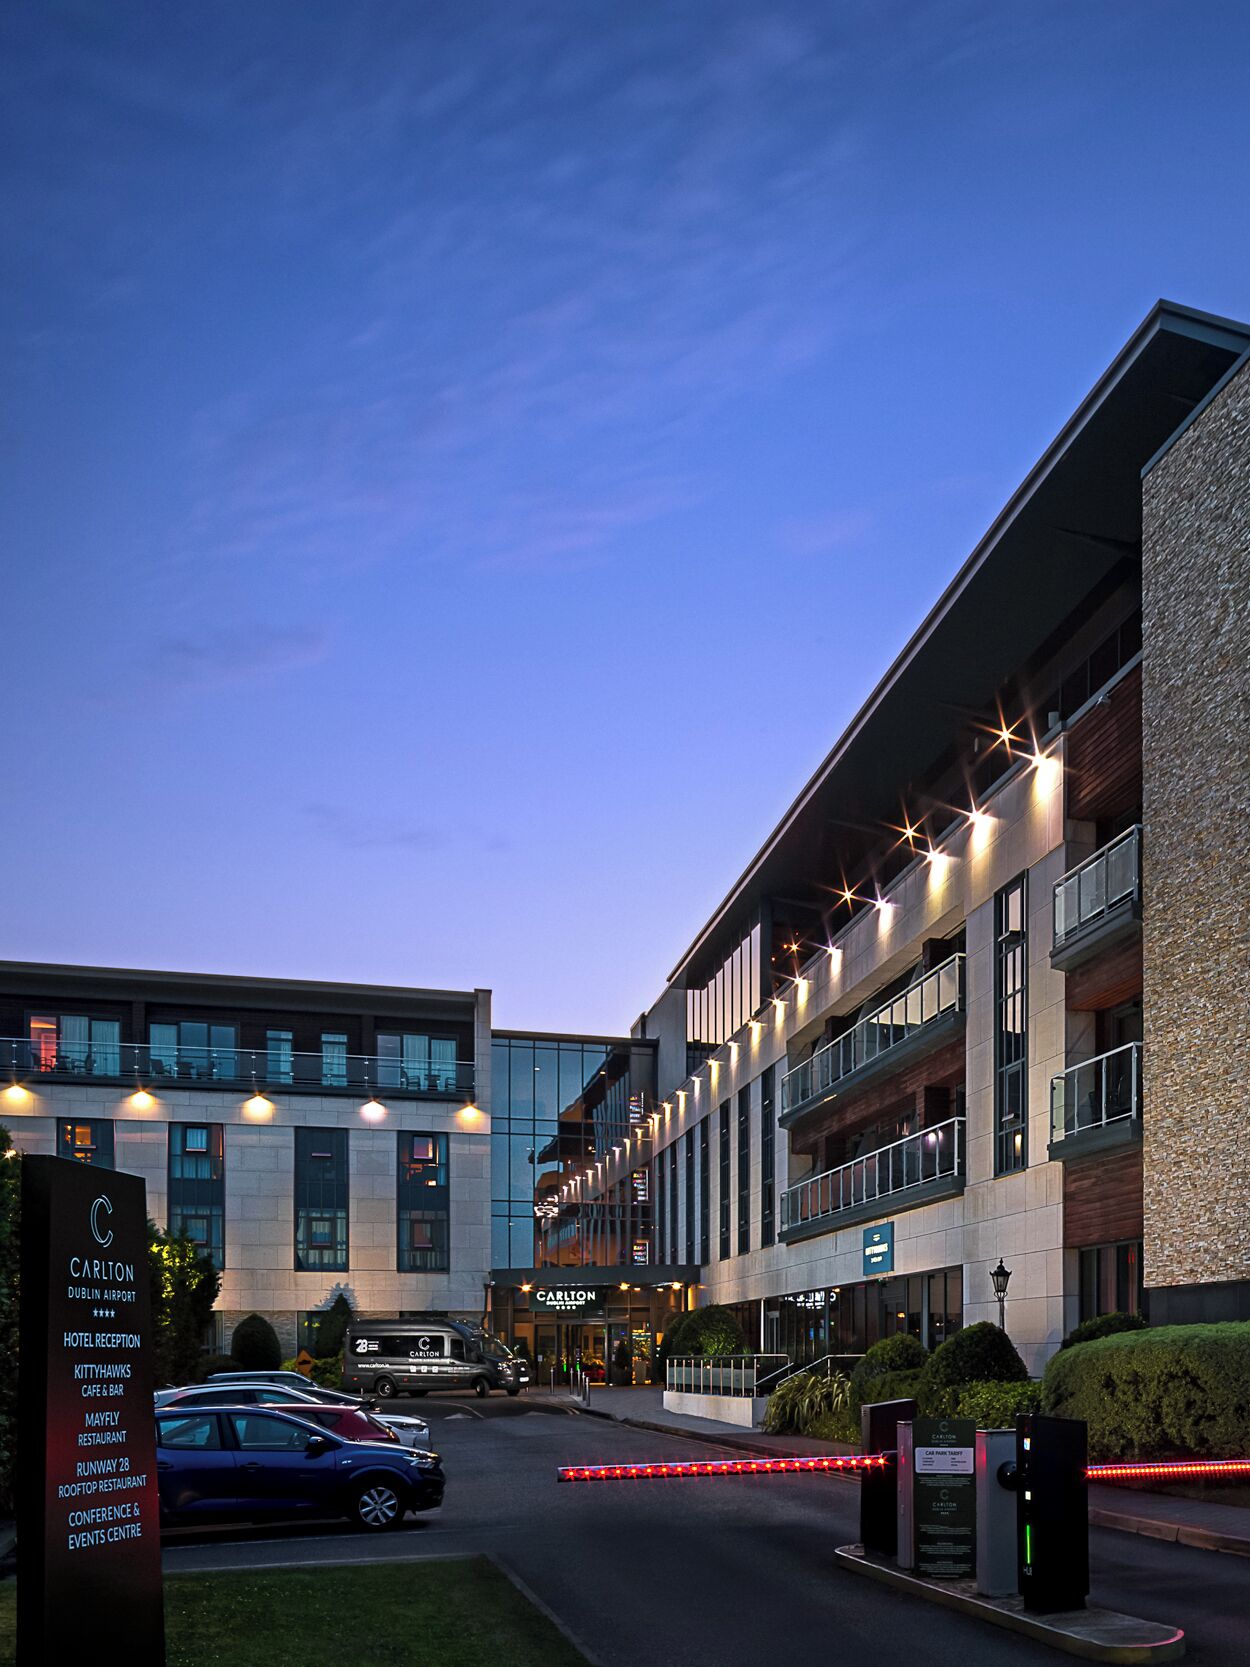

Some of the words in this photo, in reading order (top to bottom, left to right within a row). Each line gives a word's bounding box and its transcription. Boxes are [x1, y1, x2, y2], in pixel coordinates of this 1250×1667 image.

[70, 1257, 135, 1282] CARLTON
[68, 1286, 101, 1300] DUBLIN
[103, 1289, 136, 1302] AIRPORT
[536, 1290, 596, 1301] CARLTON
[63, 1332, 94, 1347] HOTEL
[95, 1333, 141, 1349] RECEPTION
[74, 1364, 132, 1379] KITTYHAWKS
[81, 1384, 101, 1398] CAFE
[102, 1384, 108, 1396] &
[109, 1383, 124, 1396] BAR
[85, 1411, 120, 1427] MAYFLY
[78, 1430, 127, 1446] RESTAURANT
[76, 1458, 118, 1477] RUNWAY
[119, 1457, 130, 1472] 28
[58, 1480, 98, 1499] ROOFTOP
[99, 1474, 147, 1493] RESTAURANT
[68, 1503, 132, 1527] CONFERENCE
[133, 1502, 140, 1516] &
[68, 1529, 106, 1550] EVENTS
[107, 1522, 142, 1542] CENTRE
